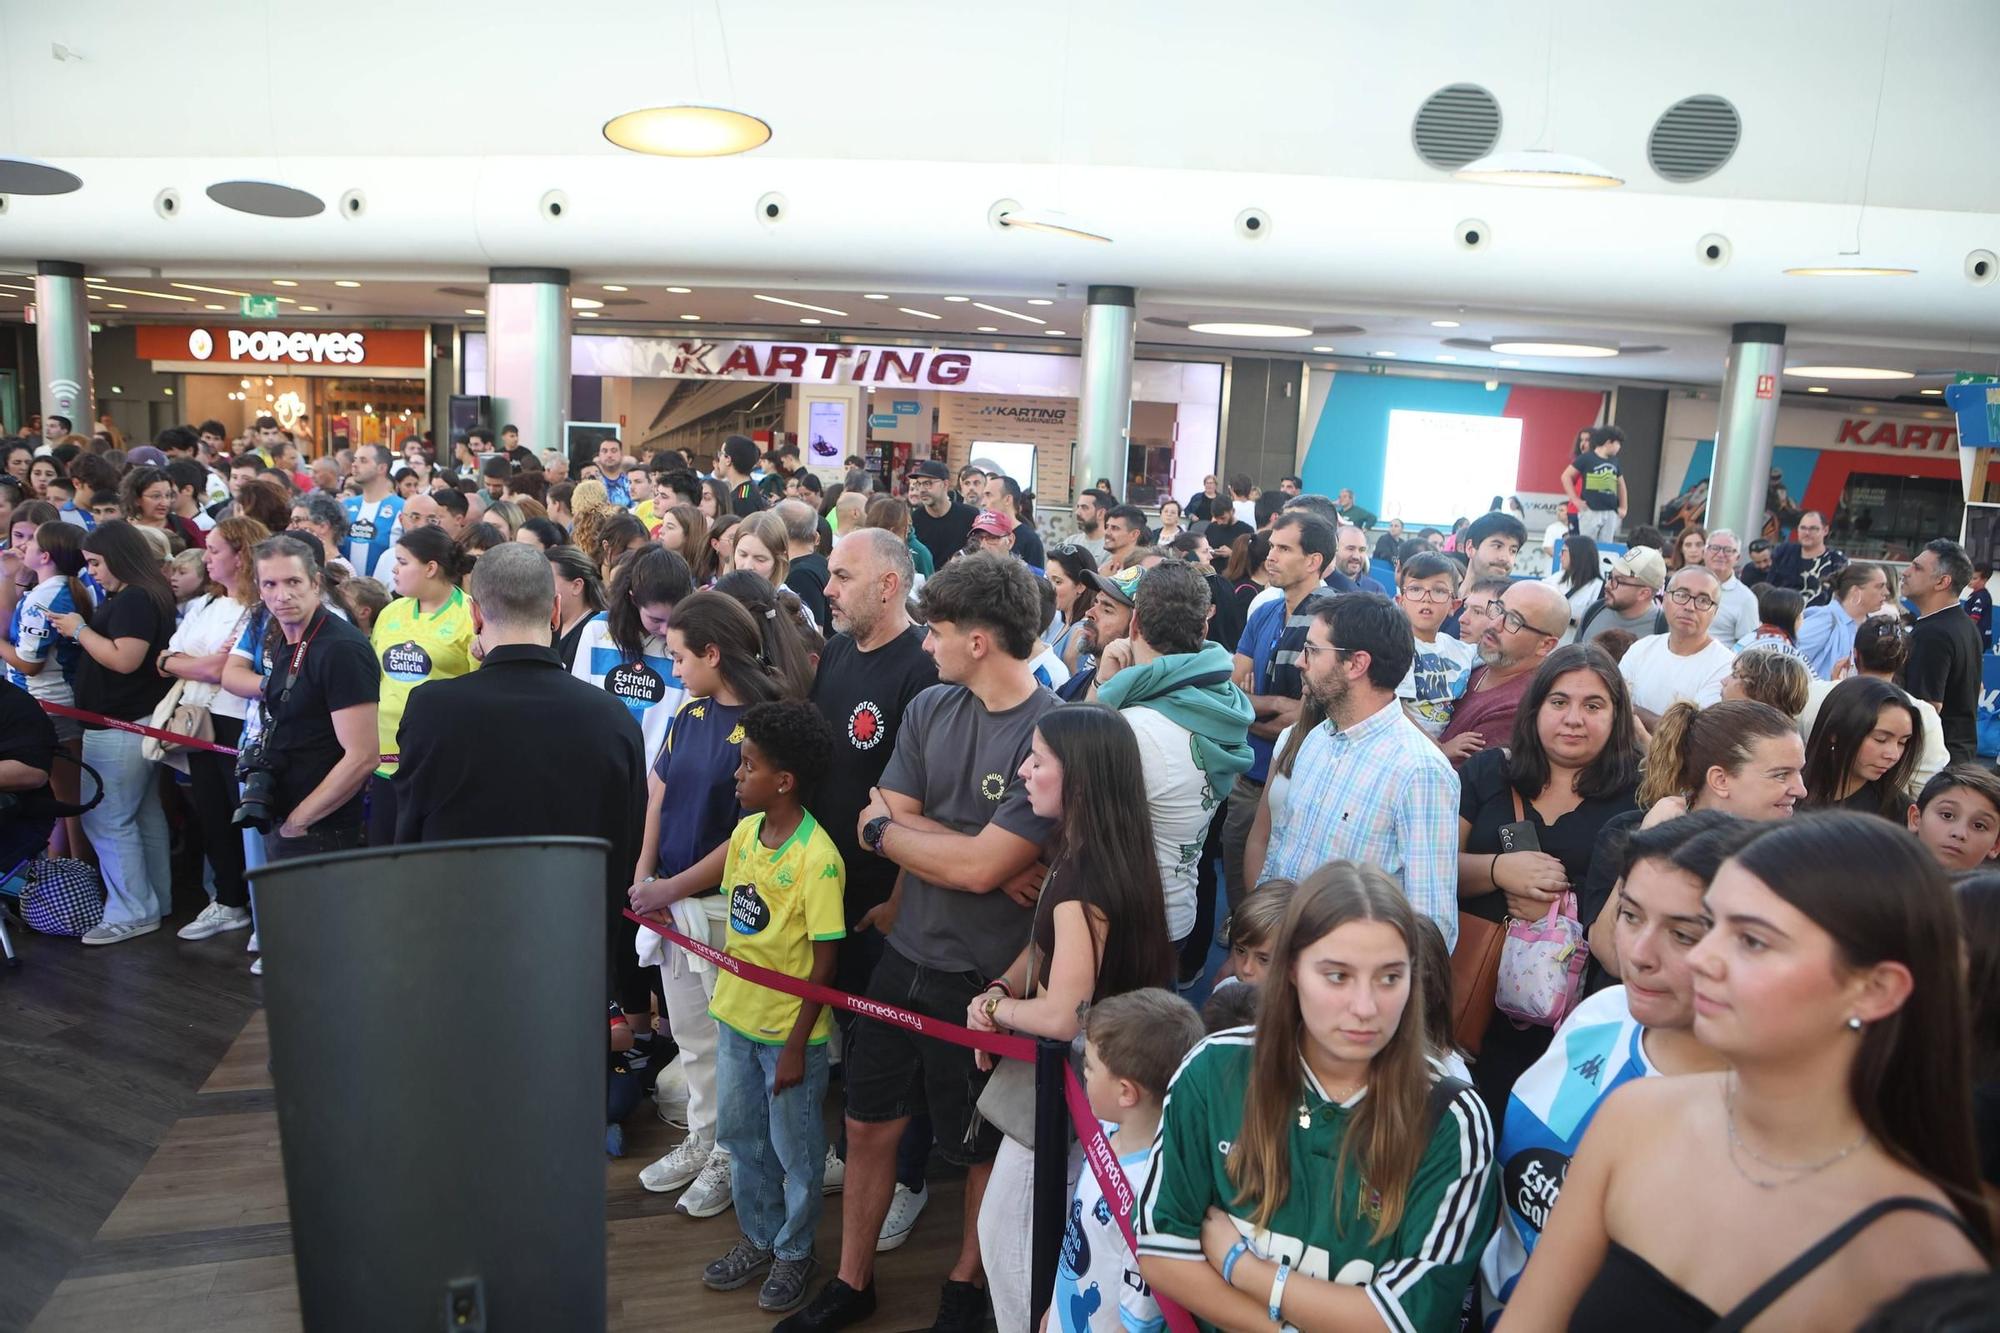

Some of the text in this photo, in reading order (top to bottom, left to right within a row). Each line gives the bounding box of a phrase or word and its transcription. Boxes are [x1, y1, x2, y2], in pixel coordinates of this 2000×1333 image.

[671, 341, 973, 385] KARTING
[996, 407, 1066, 419] KARTING
[1838, 419, 1958, 450] KART
[389, 649, 424, 663] Estrella
[389, 660, 423, 673] Galicia
[614, 670, 656, 688] Estrella
[614, 682, 652, 699] Galicia
[731, 902, 756, 926] Galicia
[733, 891, 761, 916] Estrella
[847, 996, 898, 1019] marineda
[899, 1013, 923, 1030] city
[1091, 1132, 1121, 1188] marineda
[1117, 1183, 1133, 1216] city
[1520, 1160, 1560, 1207] Estr
